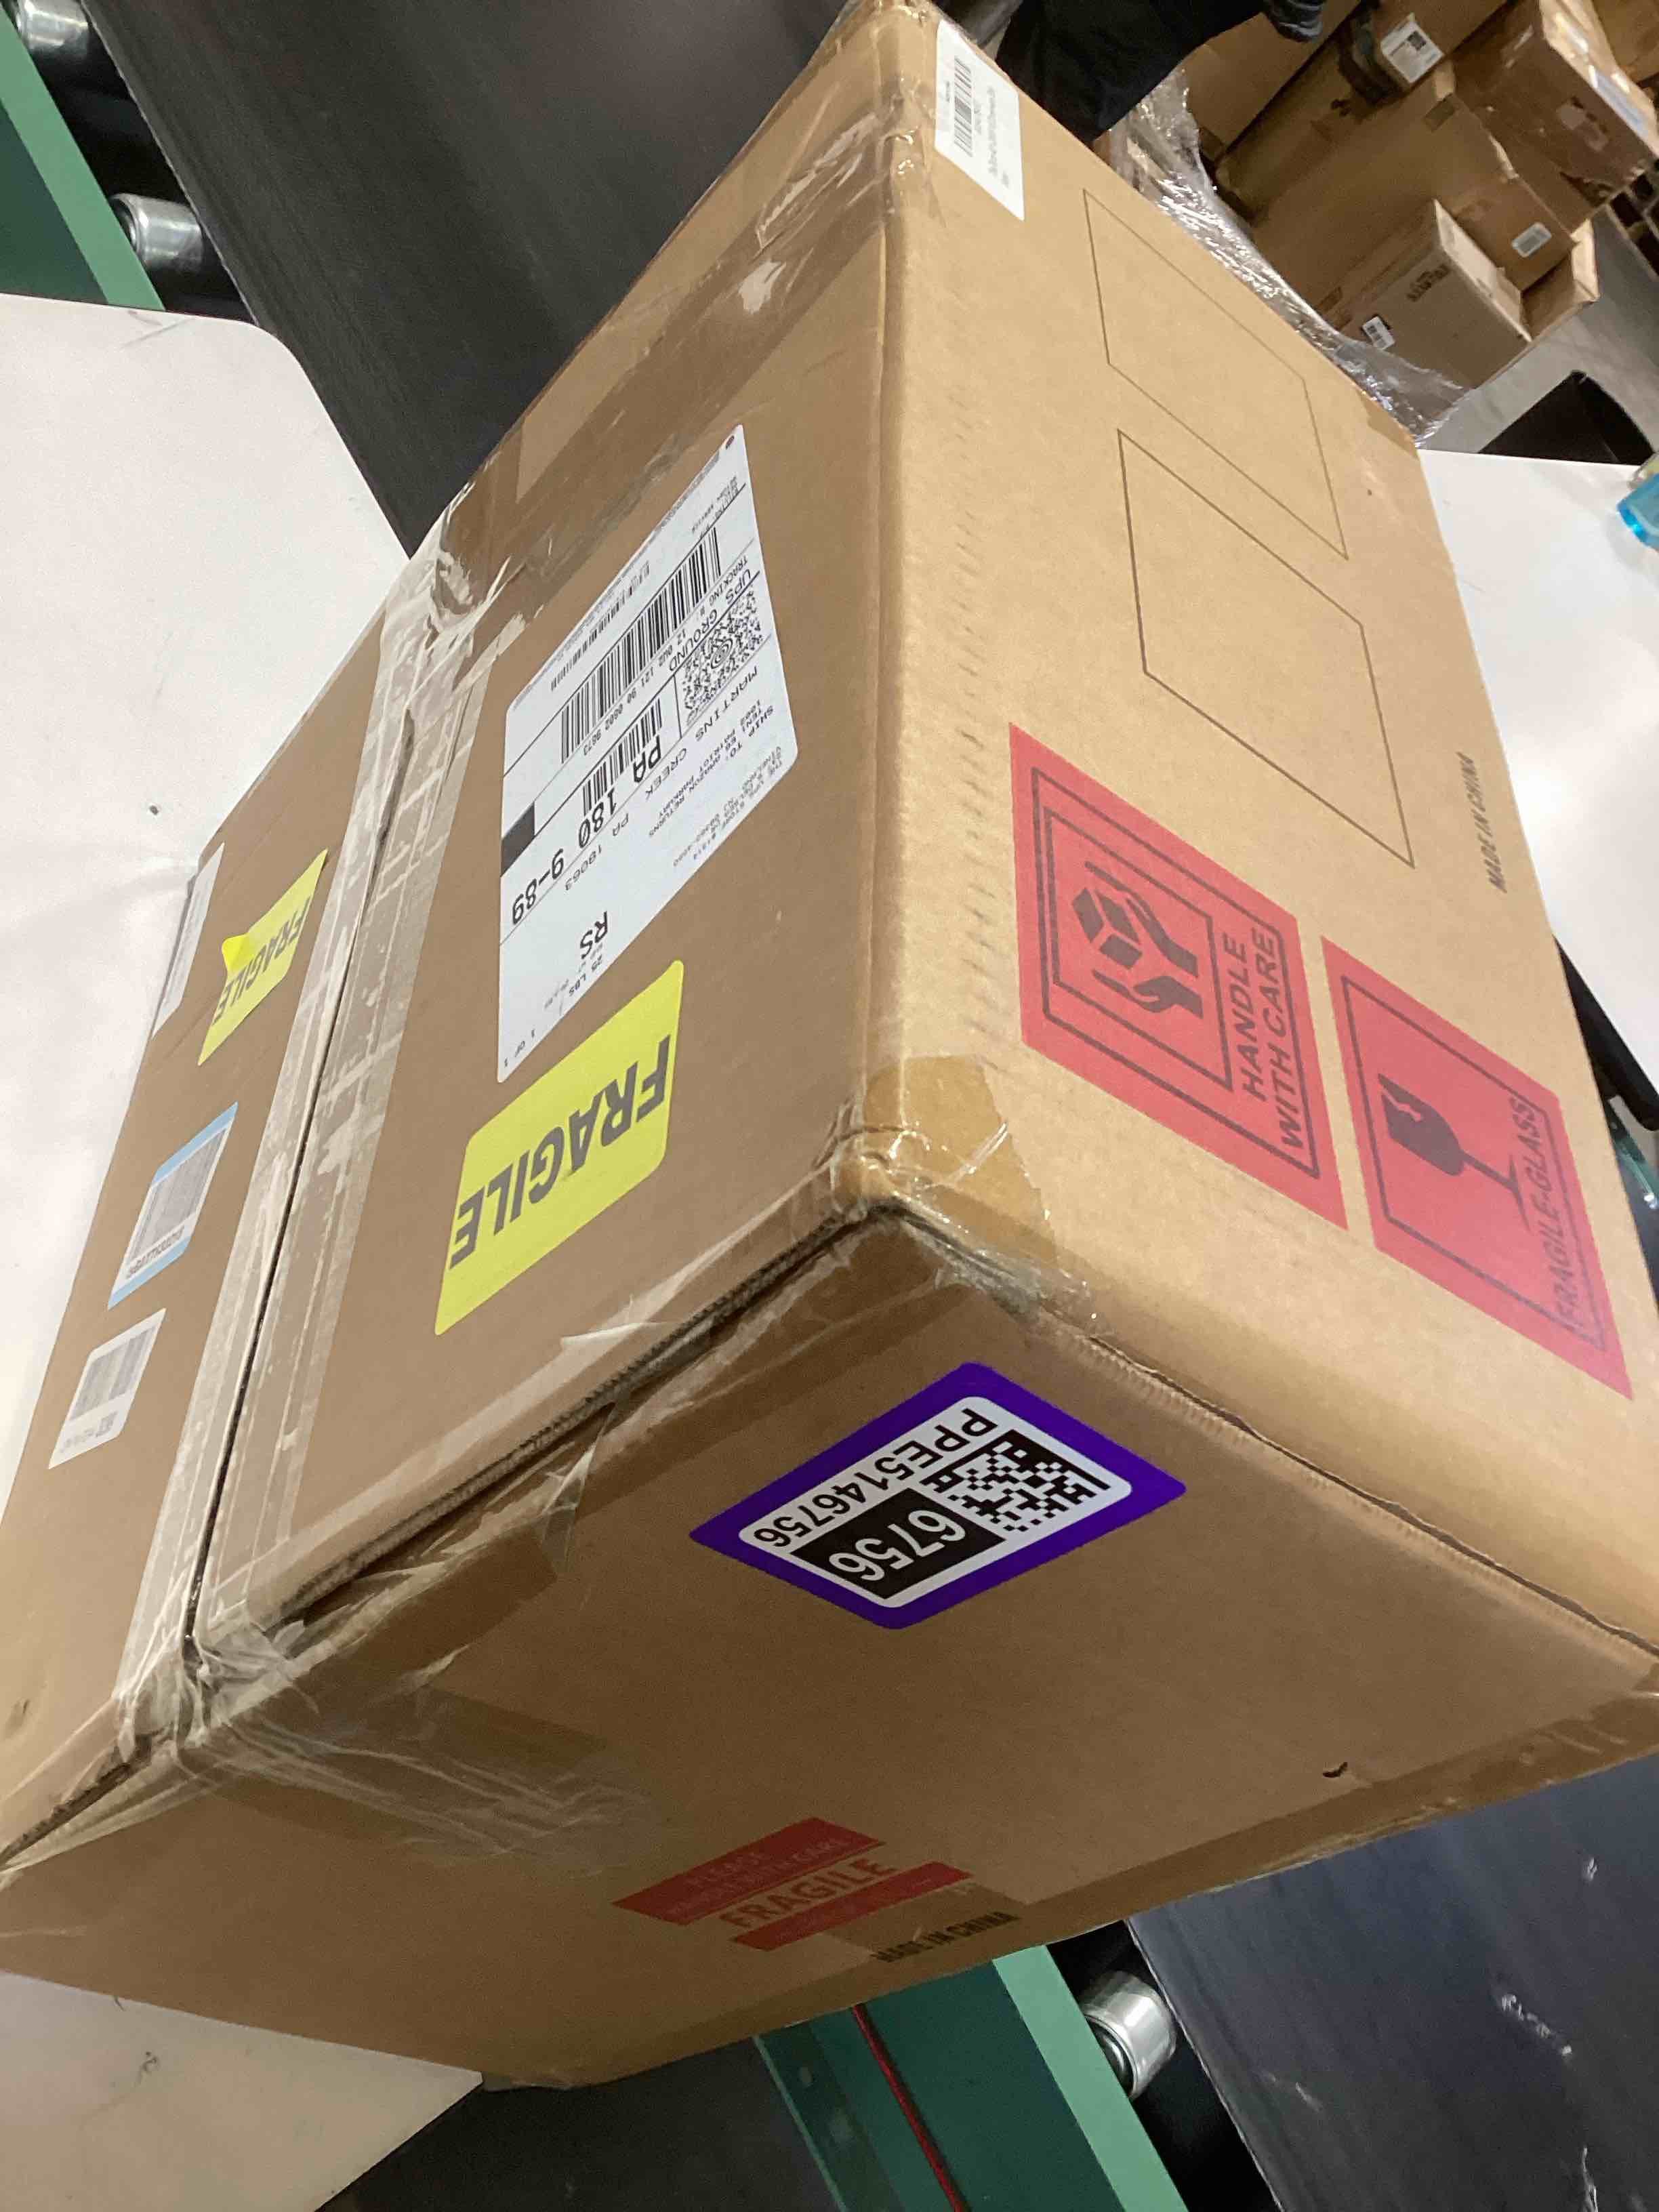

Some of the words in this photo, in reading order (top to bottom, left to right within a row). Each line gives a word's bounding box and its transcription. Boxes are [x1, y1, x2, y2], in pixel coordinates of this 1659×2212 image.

[709, 556, 747, 605] TRACKING
[725, 569, 751, 605] UPS
[669, 609, 717, 672] GROUND
[676, 628, 686, 646] 1Z
[626, 687, 636, 704] 90
[640, 666, 654, 687] 121
[695, 666, 757, 741] MARTINS
[748, 705, 773, 737] SHIP
[632, 735, 661, 783] PA
[645, 747, 687, 799] CREEK
[689, 754, 720, 792] AMAZON
[699, 729, 735, 773] PATRIOT
[659, 775, 694, 817] PARKWAY
[1456, 751, 1486, 812] CHINA
[578, 787, 616, 848] 180
[612, 813, 629, 837] PA
[649, 795, 684, 836] RETURNS
[1471, 808, 1493, 838] IN
[512, 848, 564, 925] 9-89
[565, 844, 602, 890] 18063
[1477, 832, 1508, 894] MADE
[211, 895, 312, 1027] FRAGILE
[579, 911, 608, 960] RS
[1251, 926, 1287, 1038] CARE
[1223, 933, 1268, 1103] HANDLE
[1267, 1042, 1304, 1149] WITH
[449, 1034, 671, 1269] FRAGILE
[753, 1408, 998, 1548] PPE5146756
[829, 1509, 967, 1581] 6756
[719, 1857, 898, 1928] FRAGILE
[871, 1940, 933, 1963] MADE
[945, 1911, 1021, 1938] CHINA
